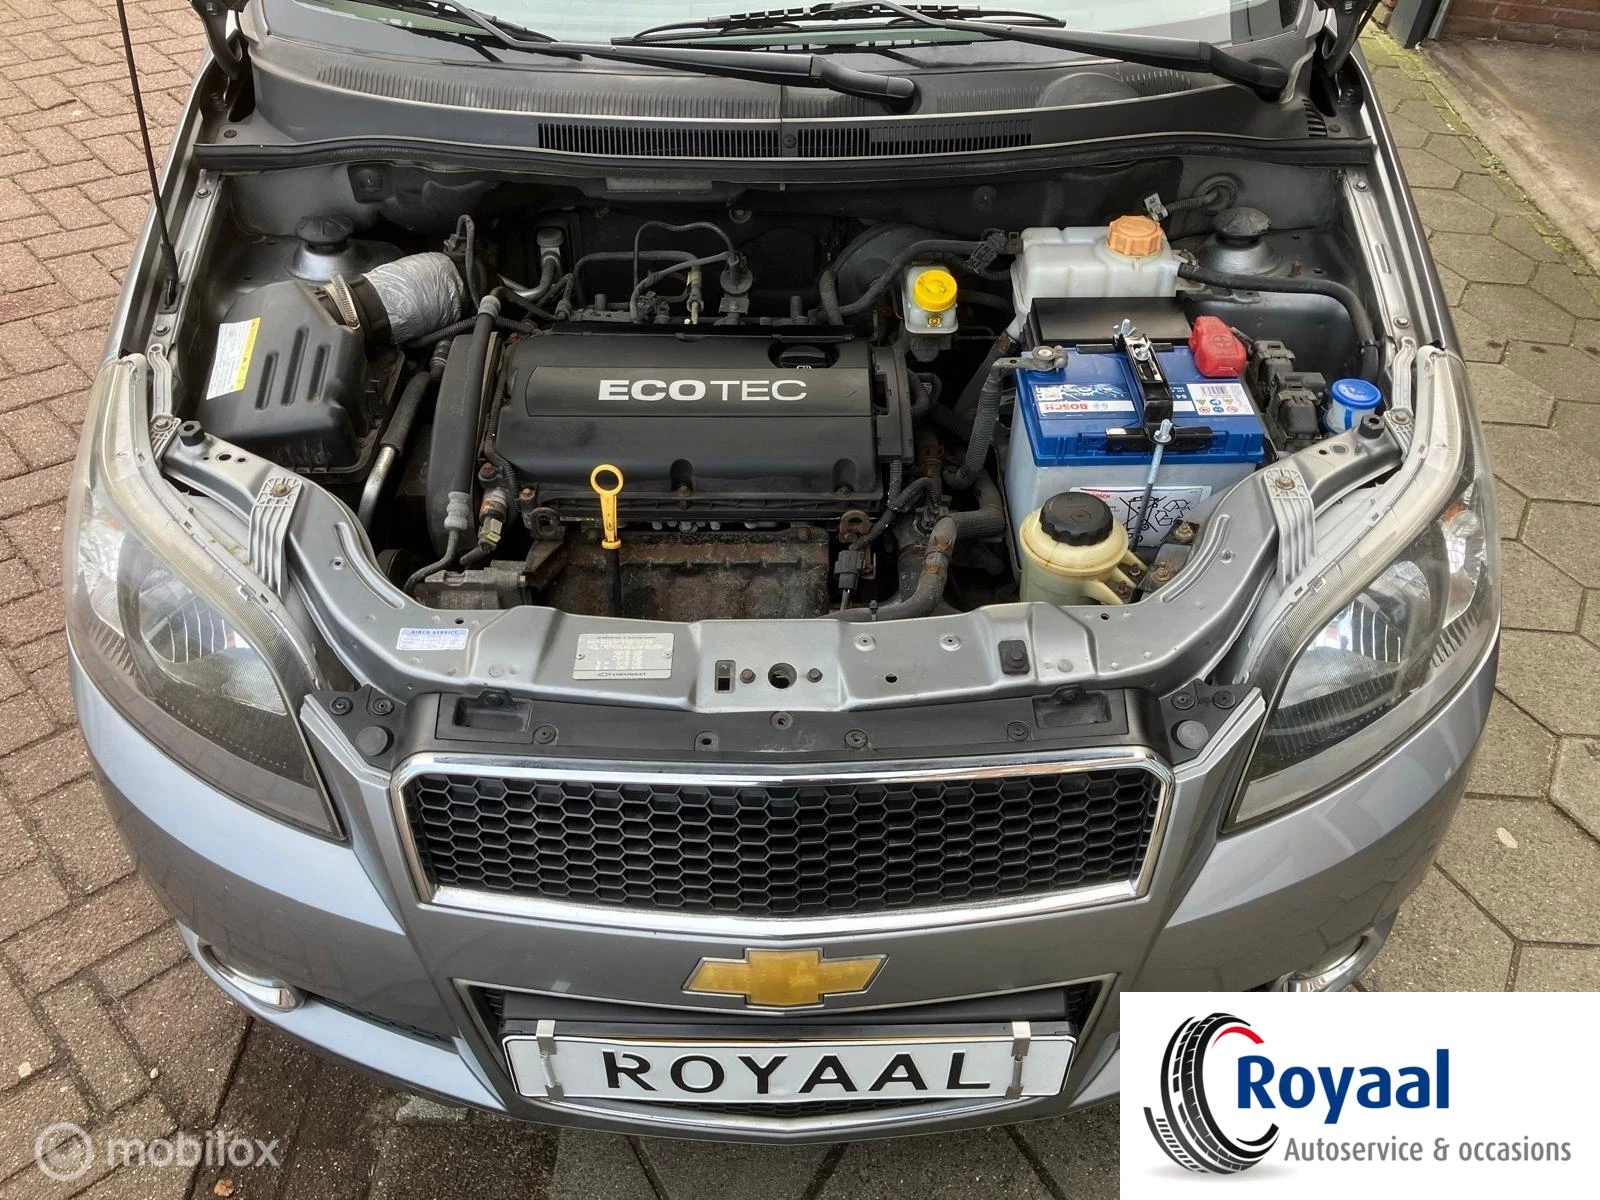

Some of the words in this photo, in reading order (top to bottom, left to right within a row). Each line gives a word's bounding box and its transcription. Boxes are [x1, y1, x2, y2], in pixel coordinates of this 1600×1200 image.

[598, 379, 808, 401] ECOTEC
[1045, 403, 1089, 411] BOSCH
[602, 1050, 991, 1094] ROYAAL
